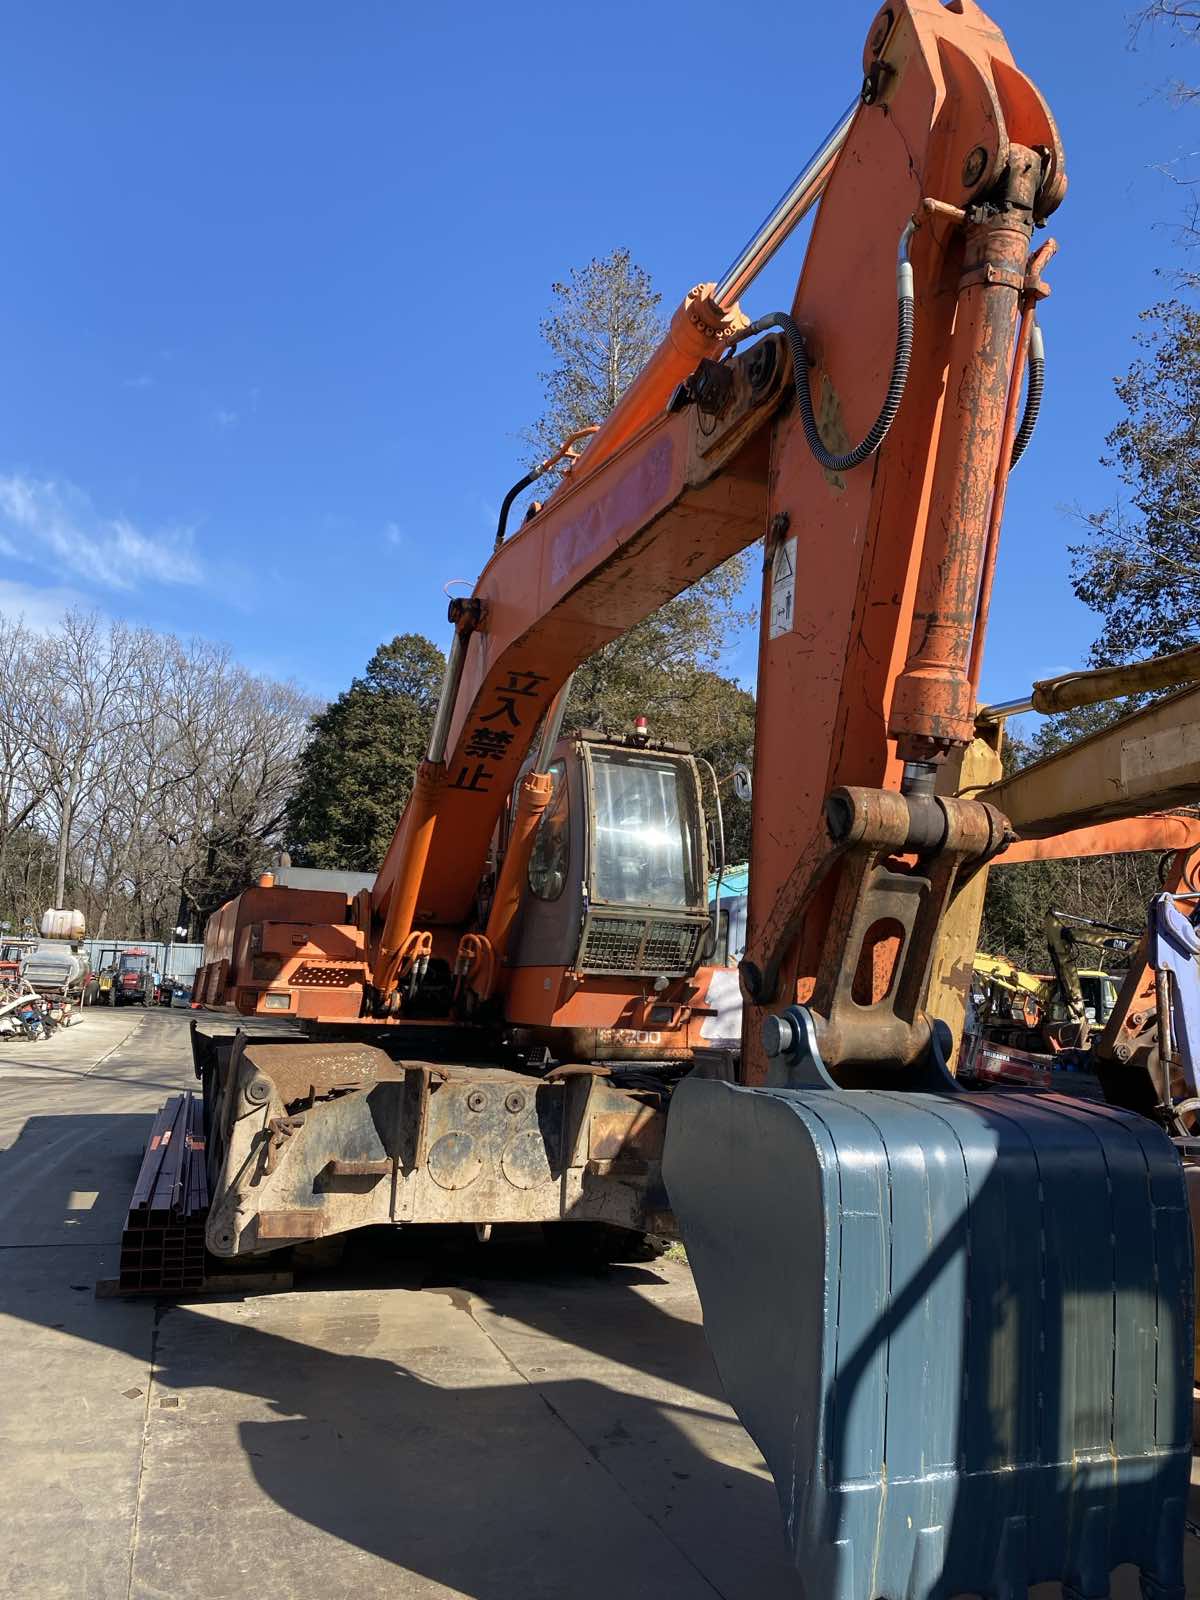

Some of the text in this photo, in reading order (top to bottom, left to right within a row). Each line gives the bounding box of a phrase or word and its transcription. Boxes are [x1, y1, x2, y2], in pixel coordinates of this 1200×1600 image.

[448, 671, 549, 792] 立入禁止
[1113, 939, 1128, 950] CAT
